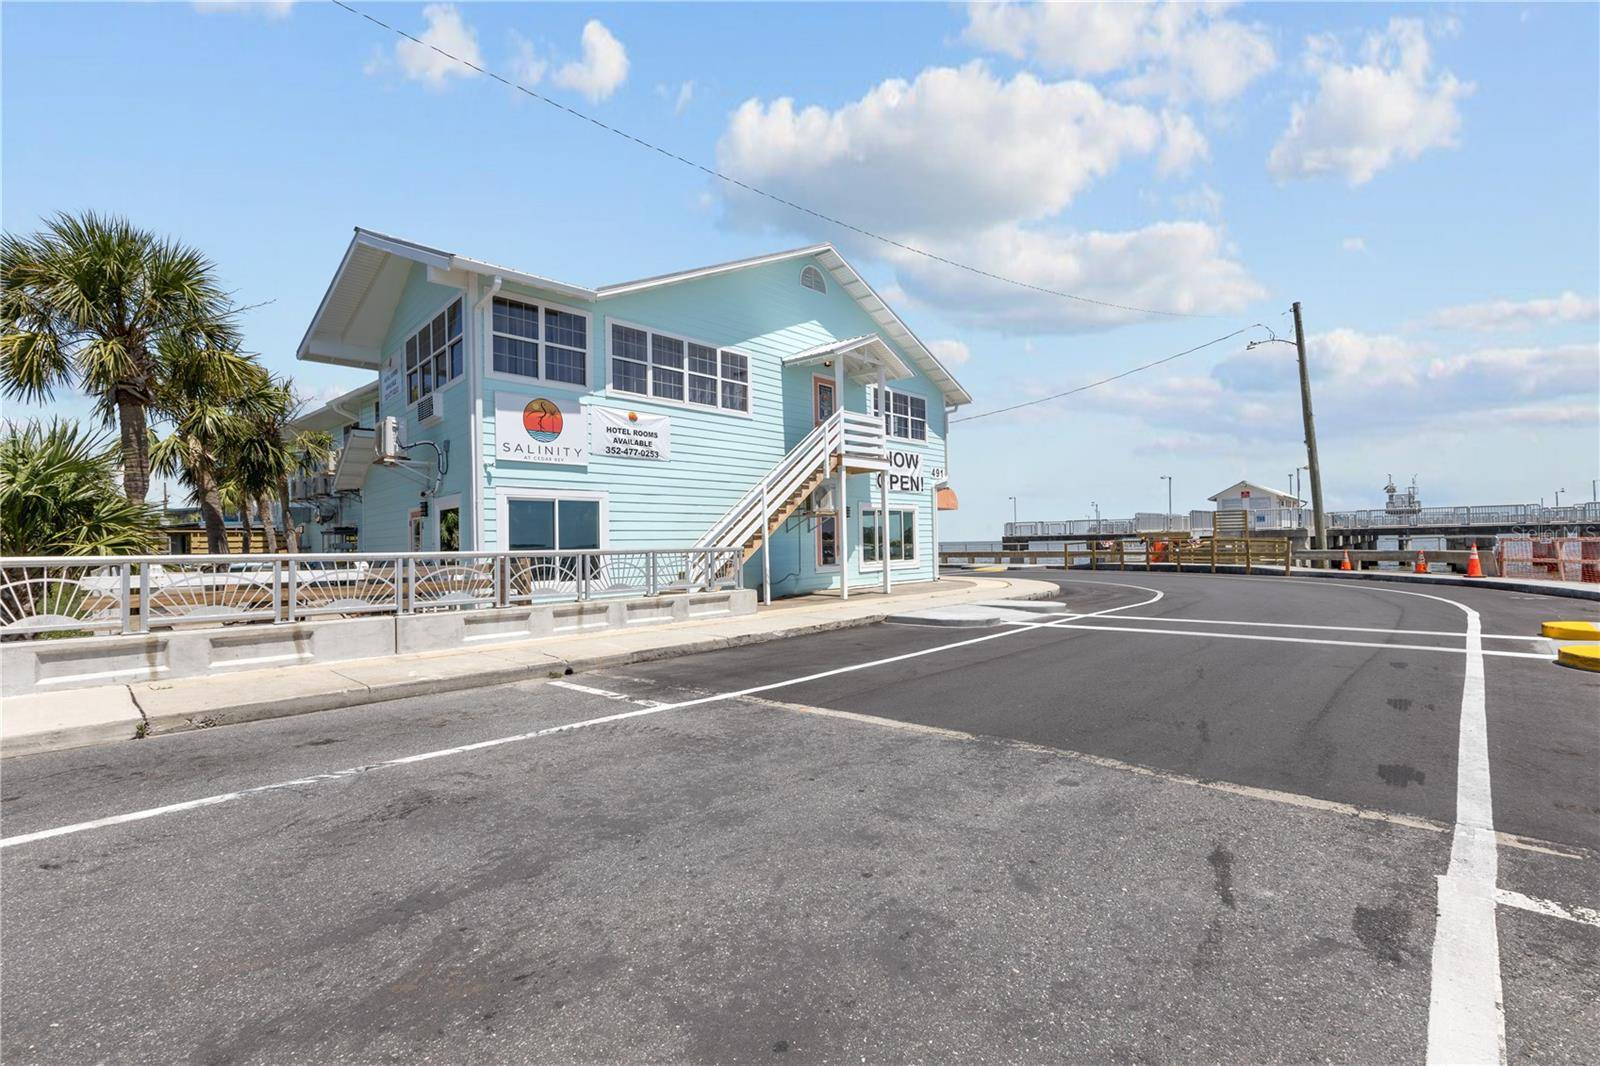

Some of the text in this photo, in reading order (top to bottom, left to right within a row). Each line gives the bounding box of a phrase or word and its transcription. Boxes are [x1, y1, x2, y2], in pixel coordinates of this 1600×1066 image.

[606, 426, 658, 439] HOTEL ROOMS
[503, 442, 582, 457] SALINITY
[613, 438, 653, 448] AVAILABLE
[605, 446, 659, 459] 352-477-0253
